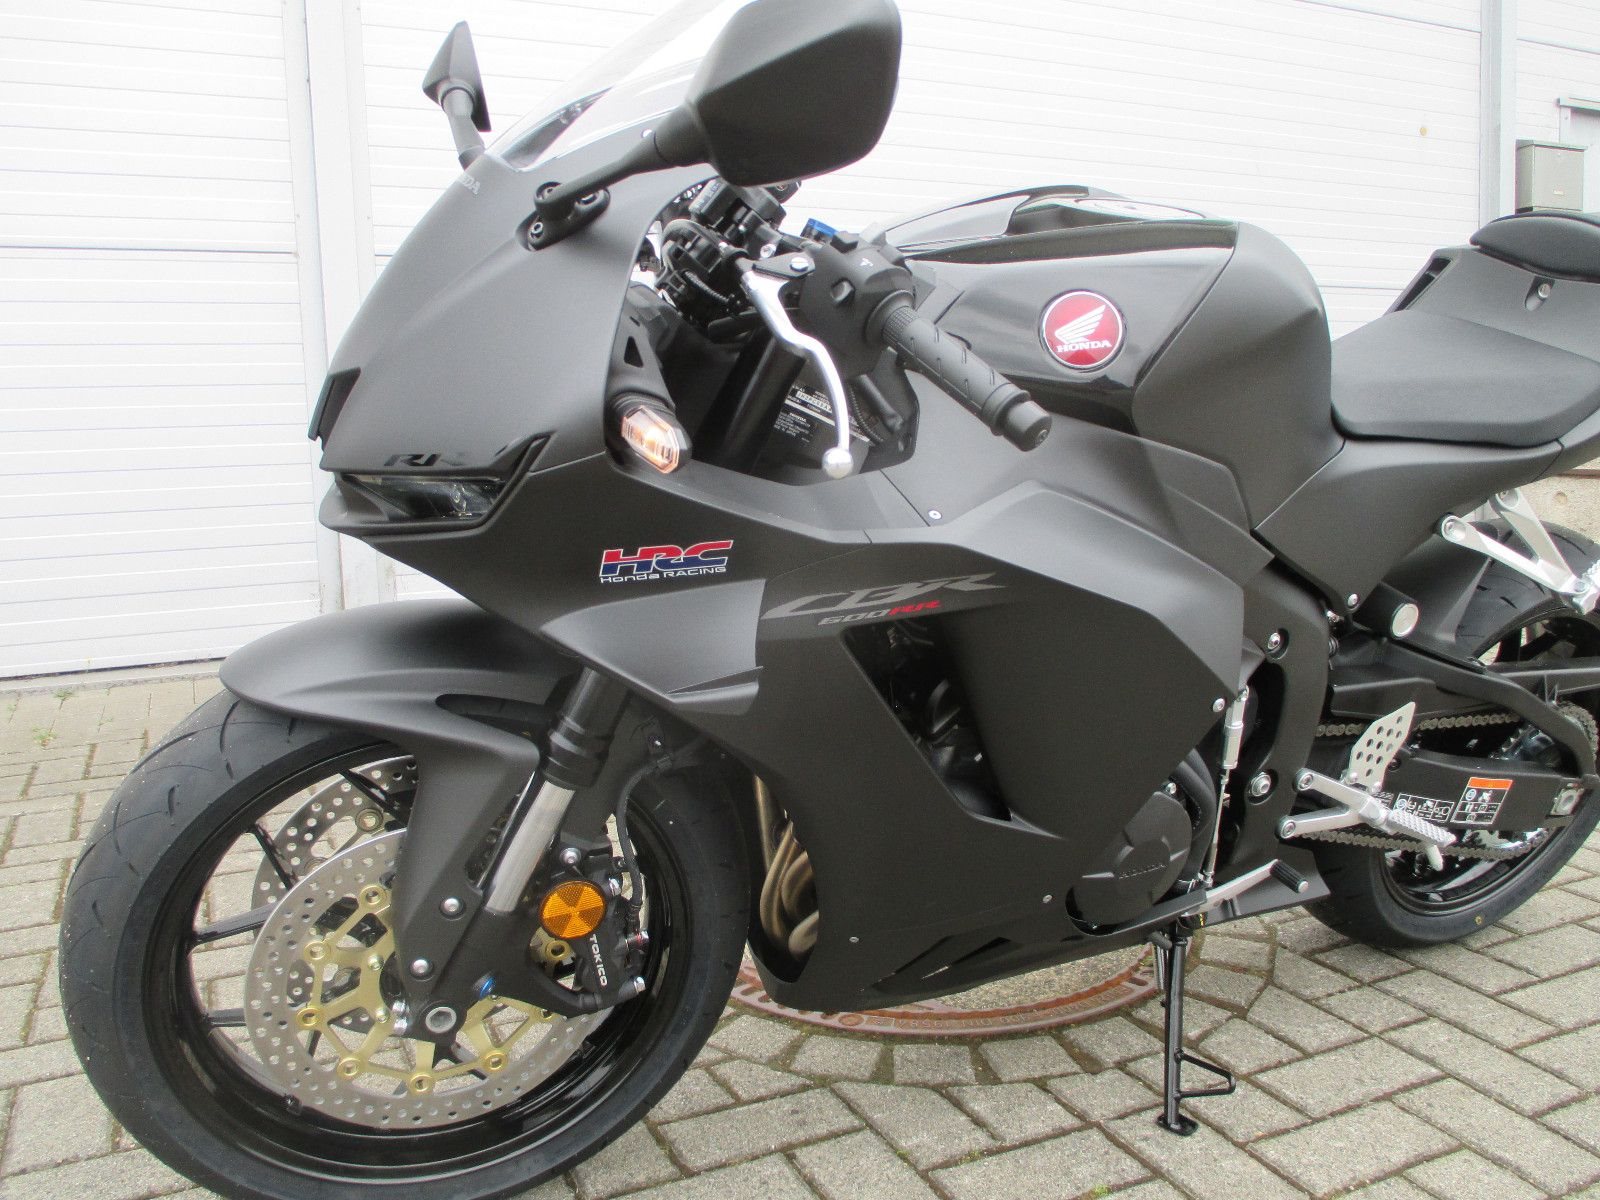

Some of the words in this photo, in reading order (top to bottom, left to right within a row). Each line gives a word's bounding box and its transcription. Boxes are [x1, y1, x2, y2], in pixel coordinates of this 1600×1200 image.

[1056, 340, 1113, 353] HONDA
[599, 540, 734, 577] HRC
[600, 573, 660, 583] Honda
[663, 566, 727, 578] RACING
[760, 572, 1008, 620] CBR
[589, 933, 608, 987] TOKICO
